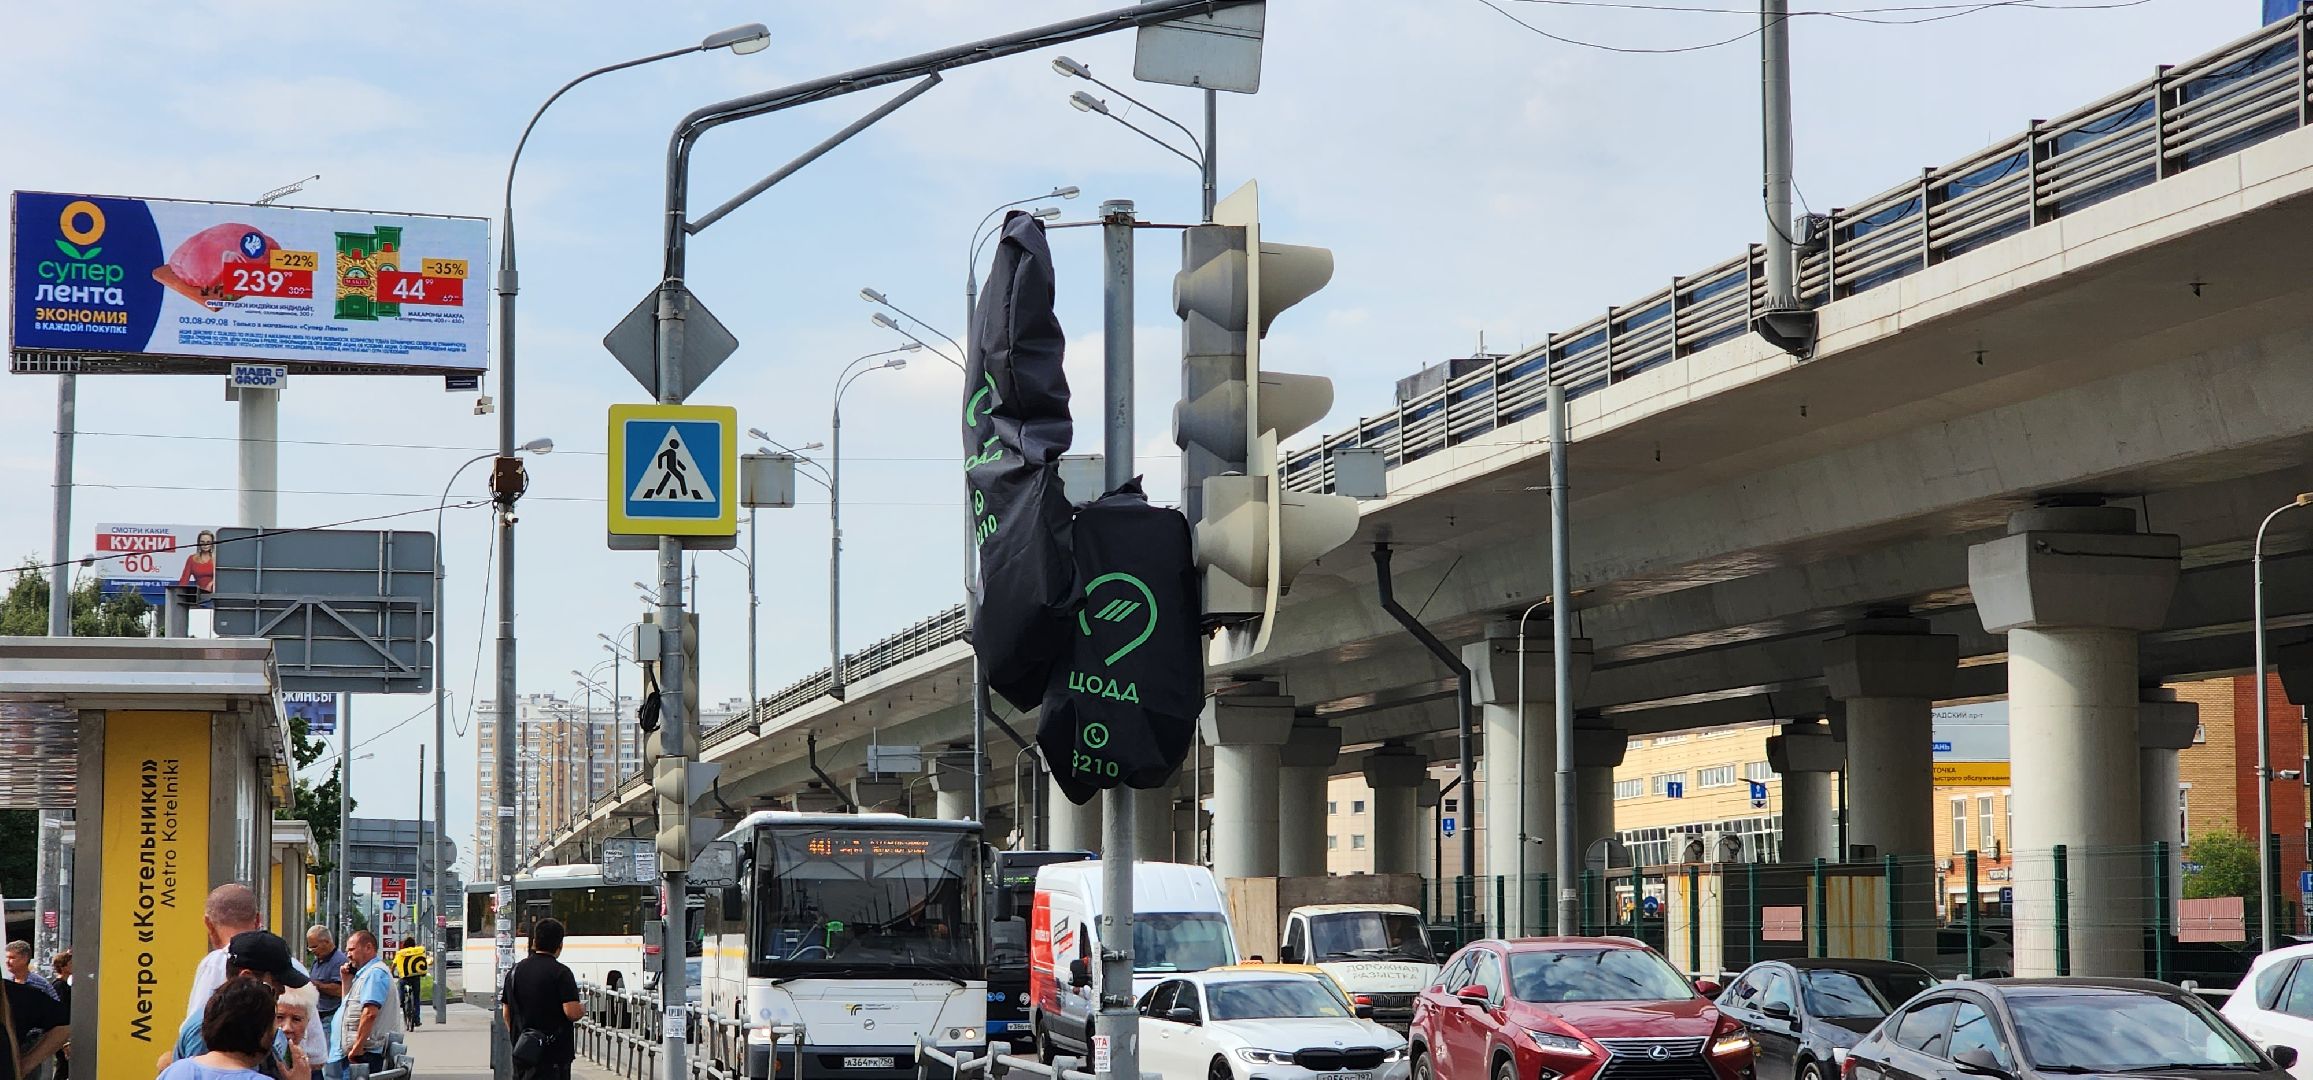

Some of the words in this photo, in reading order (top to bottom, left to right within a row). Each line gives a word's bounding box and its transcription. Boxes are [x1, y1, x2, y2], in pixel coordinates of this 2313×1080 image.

[276, 254, 314, 268] -22%
[427, 262, 464, 275] -35%
[38, 261, 124, 286] супер
[233, 269, 284, 293] 239
[35, 284, 124, 306] лента
[392, 278, 426, 300] 44
[36, 308, 128, 324] ЭКОНОМИЯ
[42, 322, 84, 332] КАЖДОЙ
[86, 325, 128, 334] ПОКУПКЕ
[235, 376, 276, 385] GROUP
[236, 367, 272, 376] MAER
[110, 536, 170, 550] КУХНИ
[1069, 671, 1139, 704] ЦОДД
[161, 759, 179, 842] Kotelniki
[133, 759, 158, 943] «Котельники»
[809, 838, 831, 855] 441
[161, 850, 176, 908] Metro
[1346, 964, 1419, 972] ДОРОЖНАЯ
[130, 952, 157, 1042] Метро
